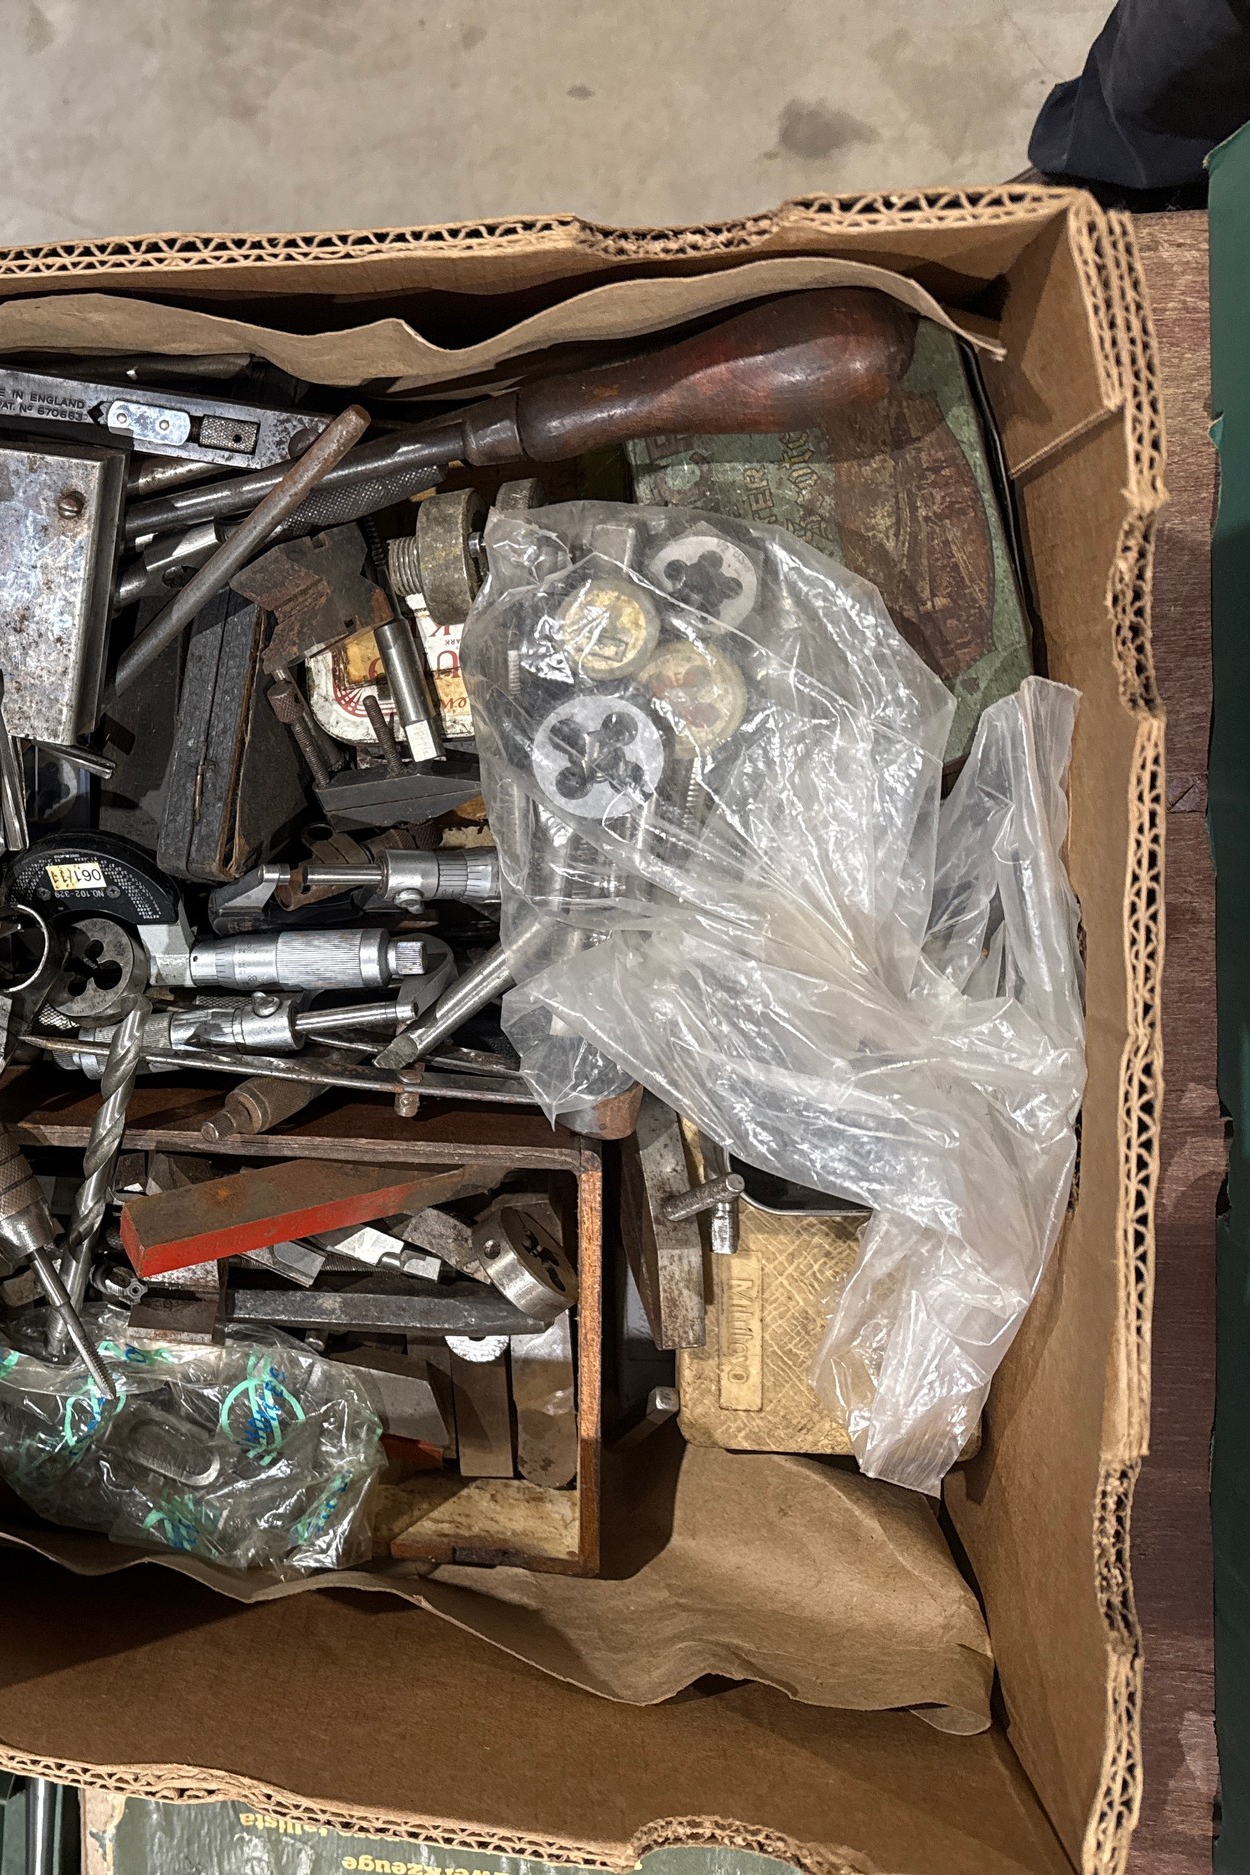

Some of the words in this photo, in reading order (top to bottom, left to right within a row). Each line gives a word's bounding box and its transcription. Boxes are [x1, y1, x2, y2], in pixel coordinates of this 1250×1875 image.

[12, 390, 24, 399] IN
[30, 393, 85, 409] ENGLAND
[727, 1276, 754, 1385] Mitutoyo
